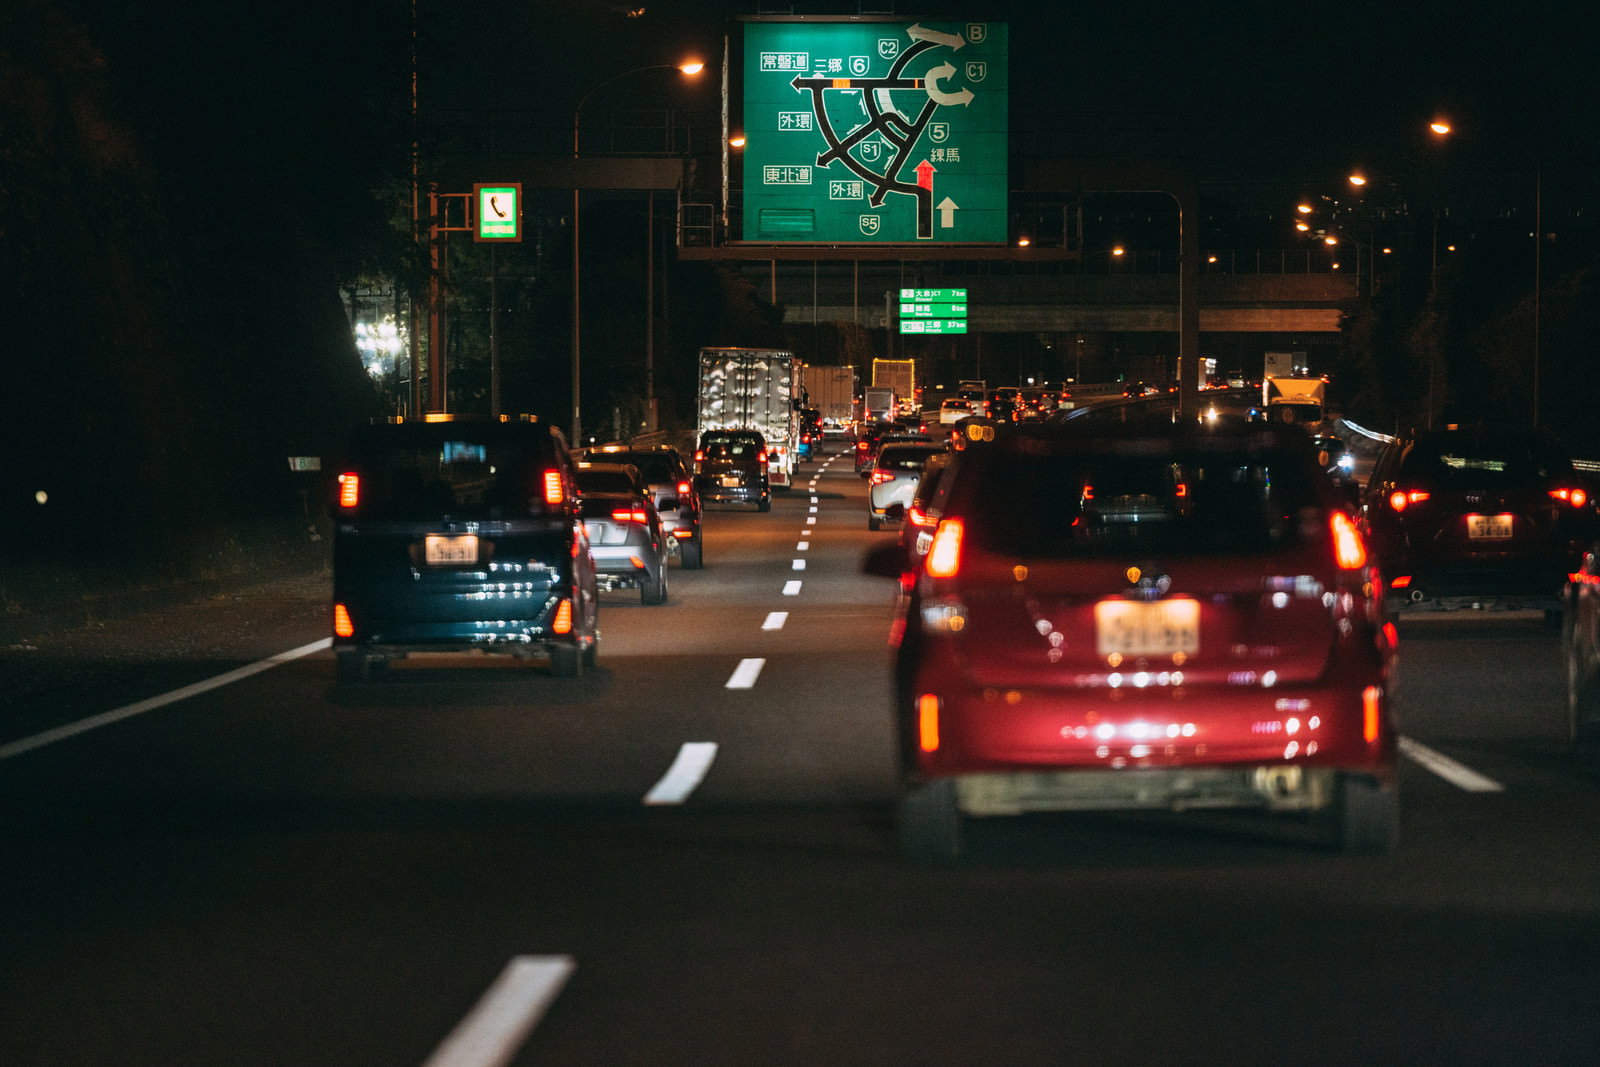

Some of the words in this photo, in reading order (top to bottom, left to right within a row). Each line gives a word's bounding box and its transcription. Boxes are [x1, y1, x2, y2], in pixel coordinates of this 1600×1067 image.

[970, 26, 983, 40] B
[880, 41, 897, 54] C2
[763, 54, 806, 70] 常磐道
[813, 58, 843, 73] 三郷
[853, 58, 866, 73] 6
[968, 64, 984, 77] C1
[780, 114, 810, 129] 外環
[932, 125, 945, 139] 5
[863, 144, 878, 156] S1
[930, 148, 960, 162] 練馬
[766, 168, 810, 182] 東北道
[832, 183, 861, 197] 外環
[862, 218, 878, 230] S5
